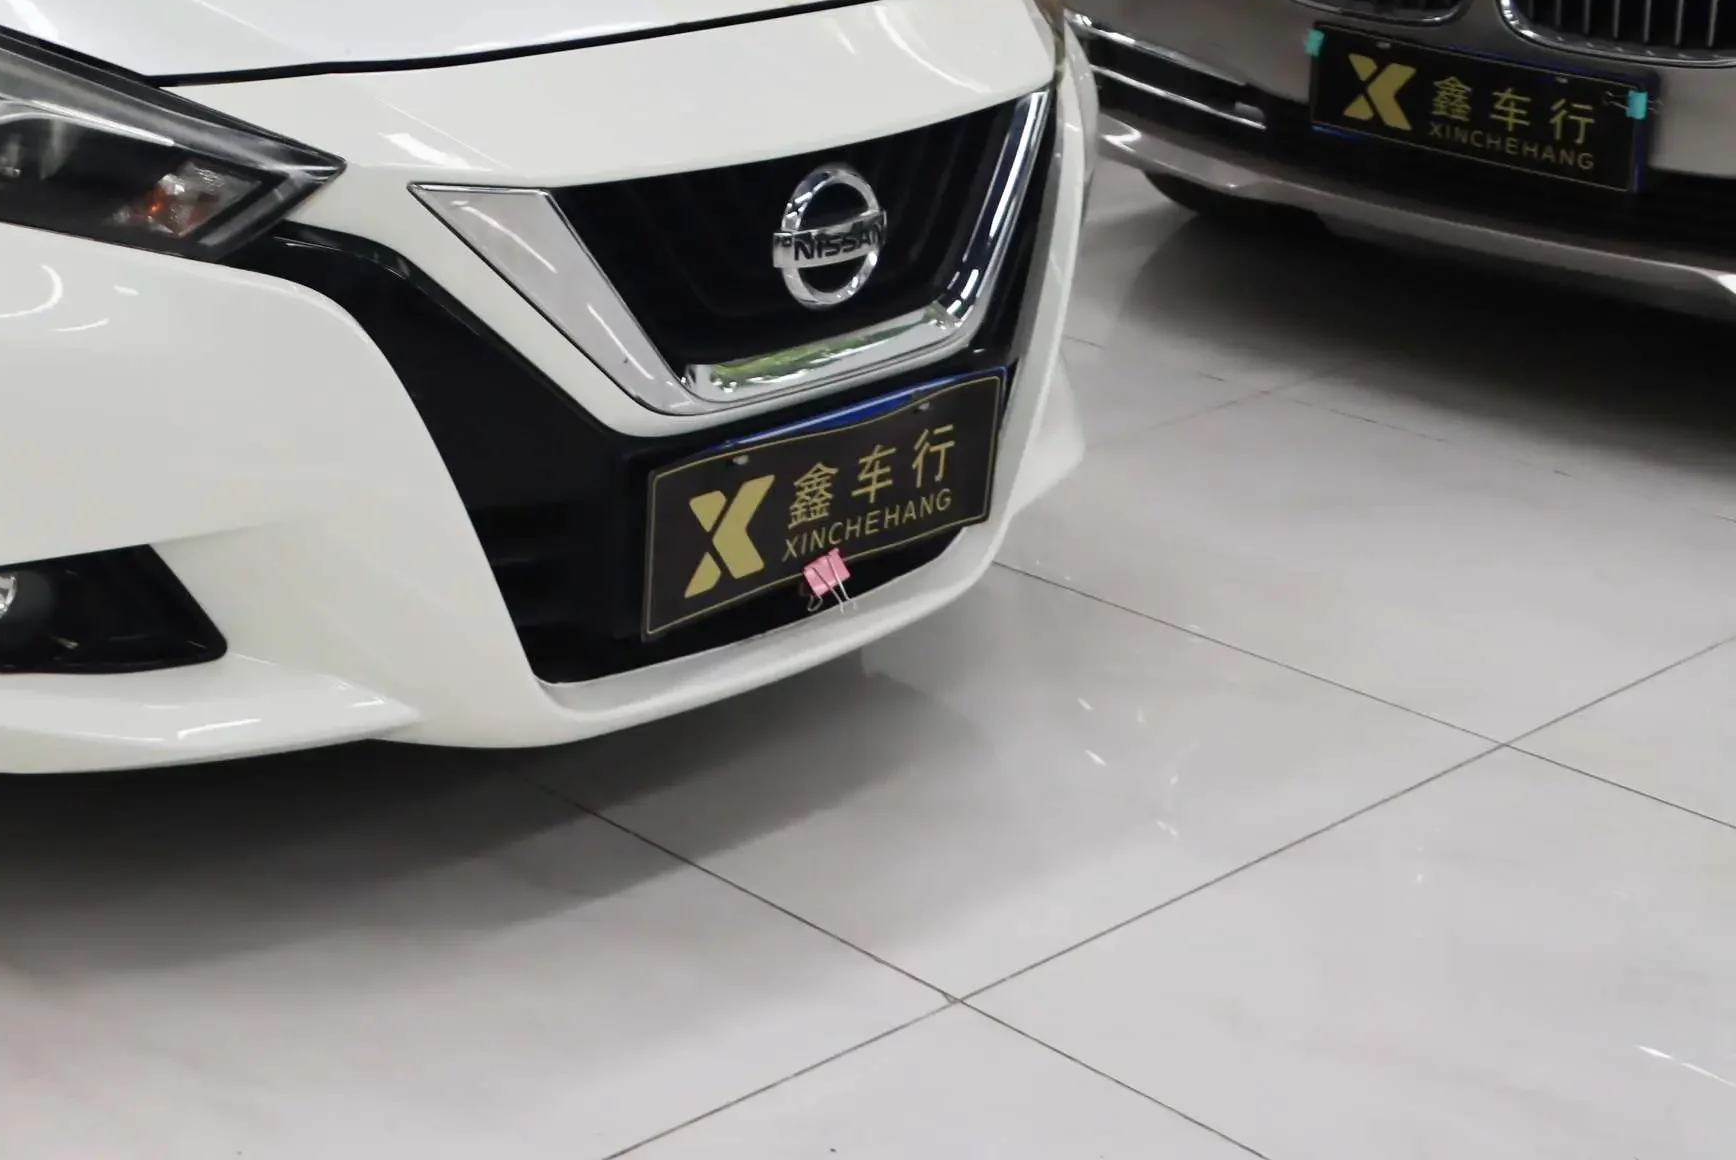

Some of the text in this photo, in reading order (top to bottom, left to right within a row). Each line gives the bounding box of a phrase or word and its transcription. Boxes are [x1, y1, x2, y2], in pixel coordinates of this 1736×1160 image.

[1430, 75, 1596, 145] 鑫车行
[1429, 121, 1595, 171] XINCHEHANG
[794, 224, 881, 261] NISSAN
[787, 424, 956, 530] 鑫车行
[781, 488, 953, 563] XINCHEHANG
